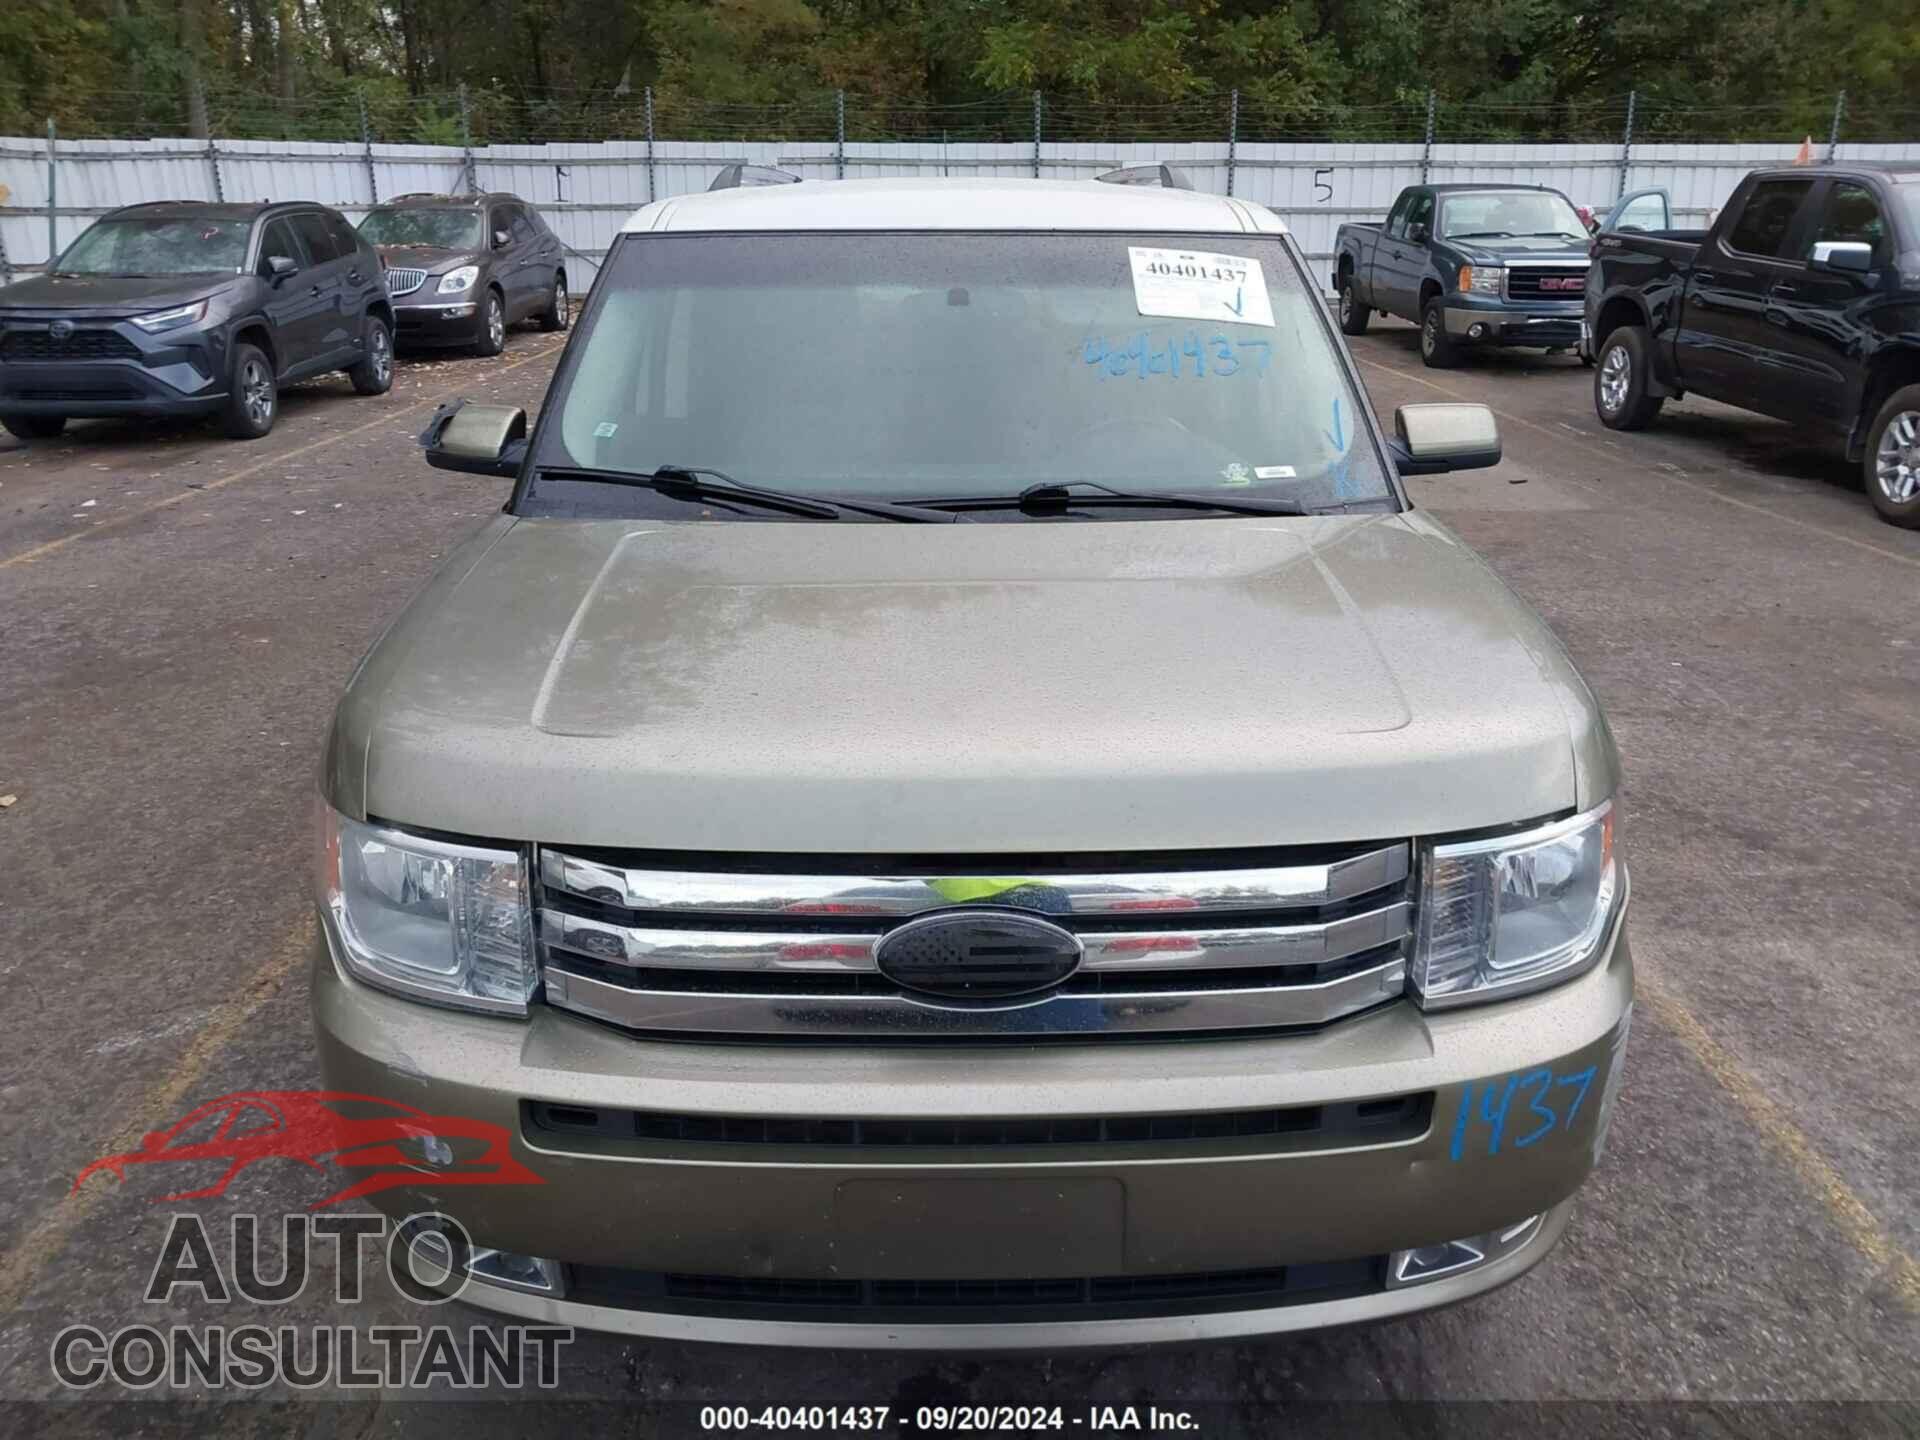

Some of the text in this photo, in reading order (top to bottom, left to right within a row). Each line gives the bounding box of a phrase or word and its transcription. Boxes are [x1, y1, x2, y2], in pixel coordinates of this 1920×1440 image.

[1314, 167, 1334, 203] 5
[1145, 261, 1247, 283] 40401437
[1450, 1065, 1598, 1162] 1437
